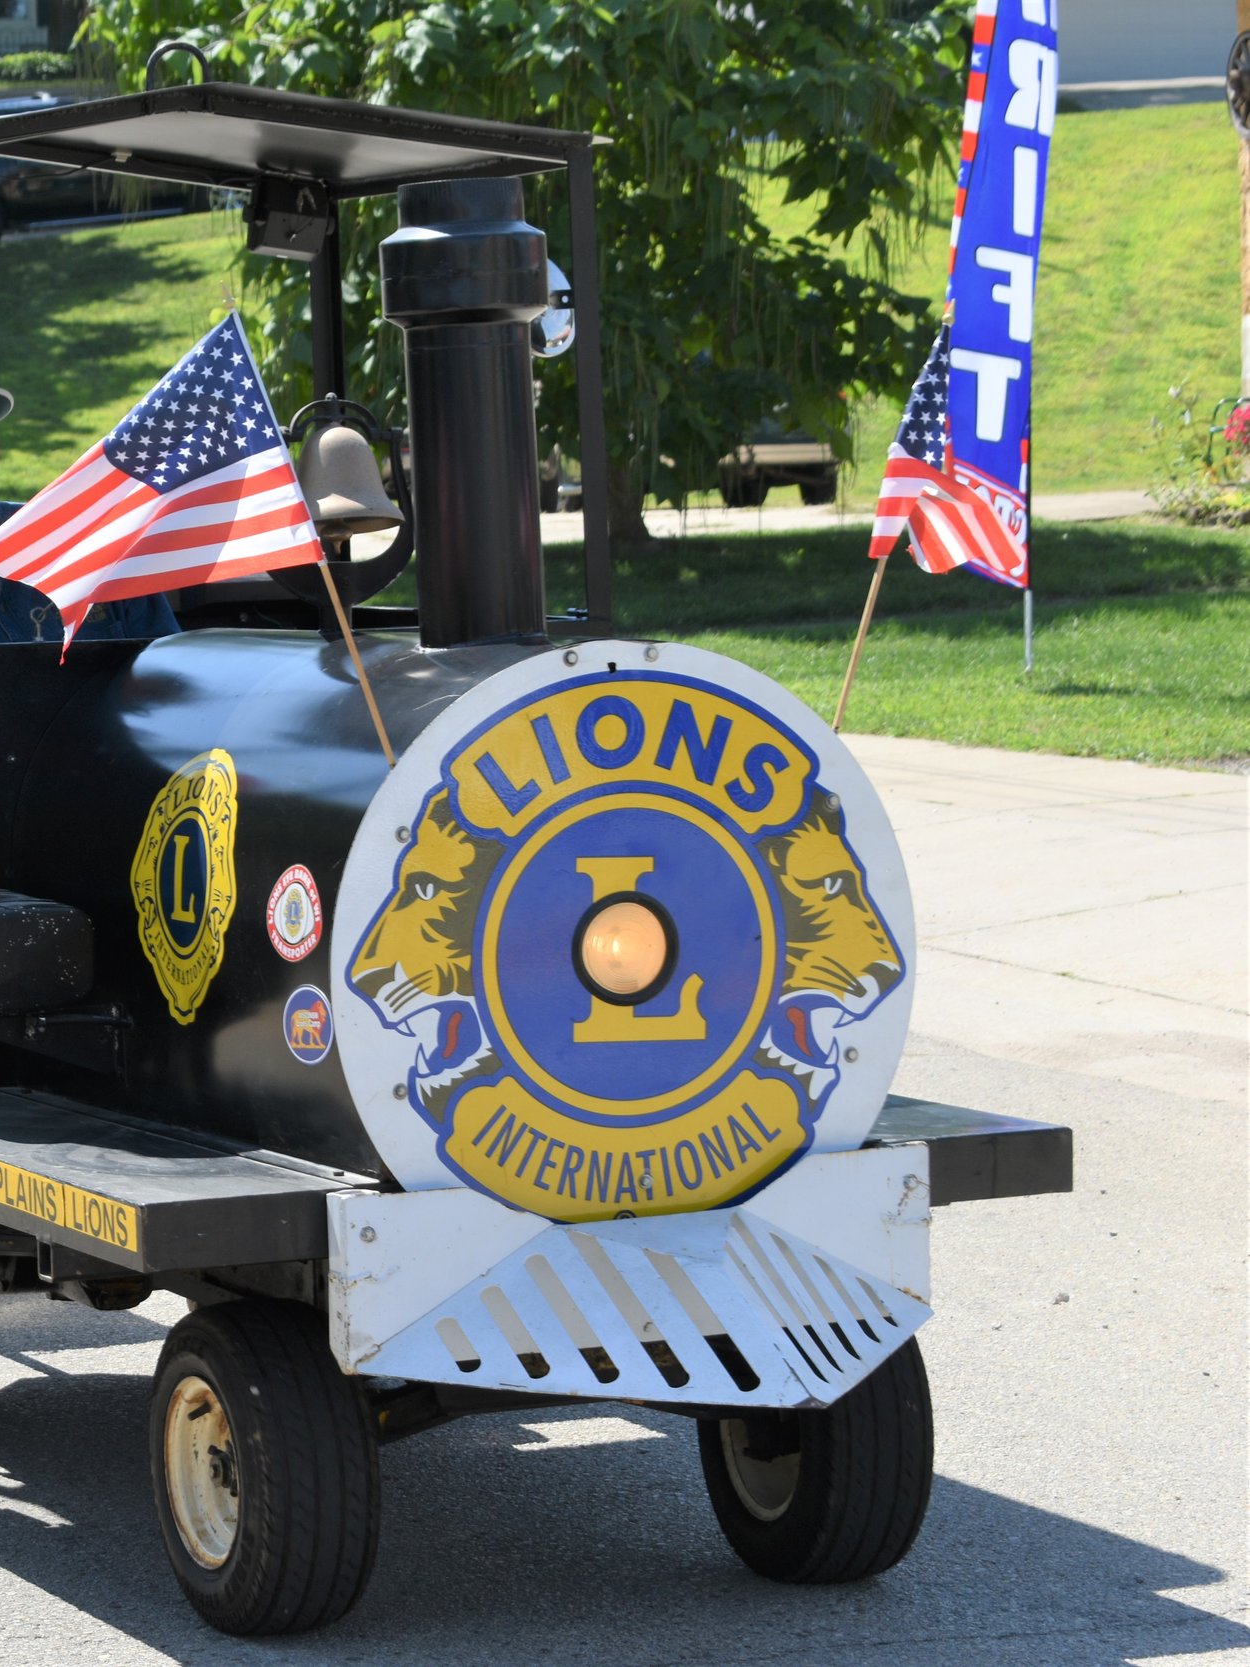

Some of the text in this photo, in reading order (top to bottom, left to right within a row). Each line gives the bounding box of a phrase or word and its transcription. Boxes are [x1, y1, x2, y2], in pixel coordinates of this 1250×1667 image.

[473, 694, 790, 817] LIONS
[172, 774, 223, 817] LIONS
[170, 833, 196, 924] L
[268, 882, 283, 925] LIONS
[282, 870, 294, 887] EYE
[153, 931, 212, 986] INTERNATIONAL
[271, 929, 318, 959] TRANSPORTER
[572, 856, 707, 1043] L
[470, 1101, 781, 1205] INTERNATIONAL
[72, 1191, 128, 1247] LIONS
